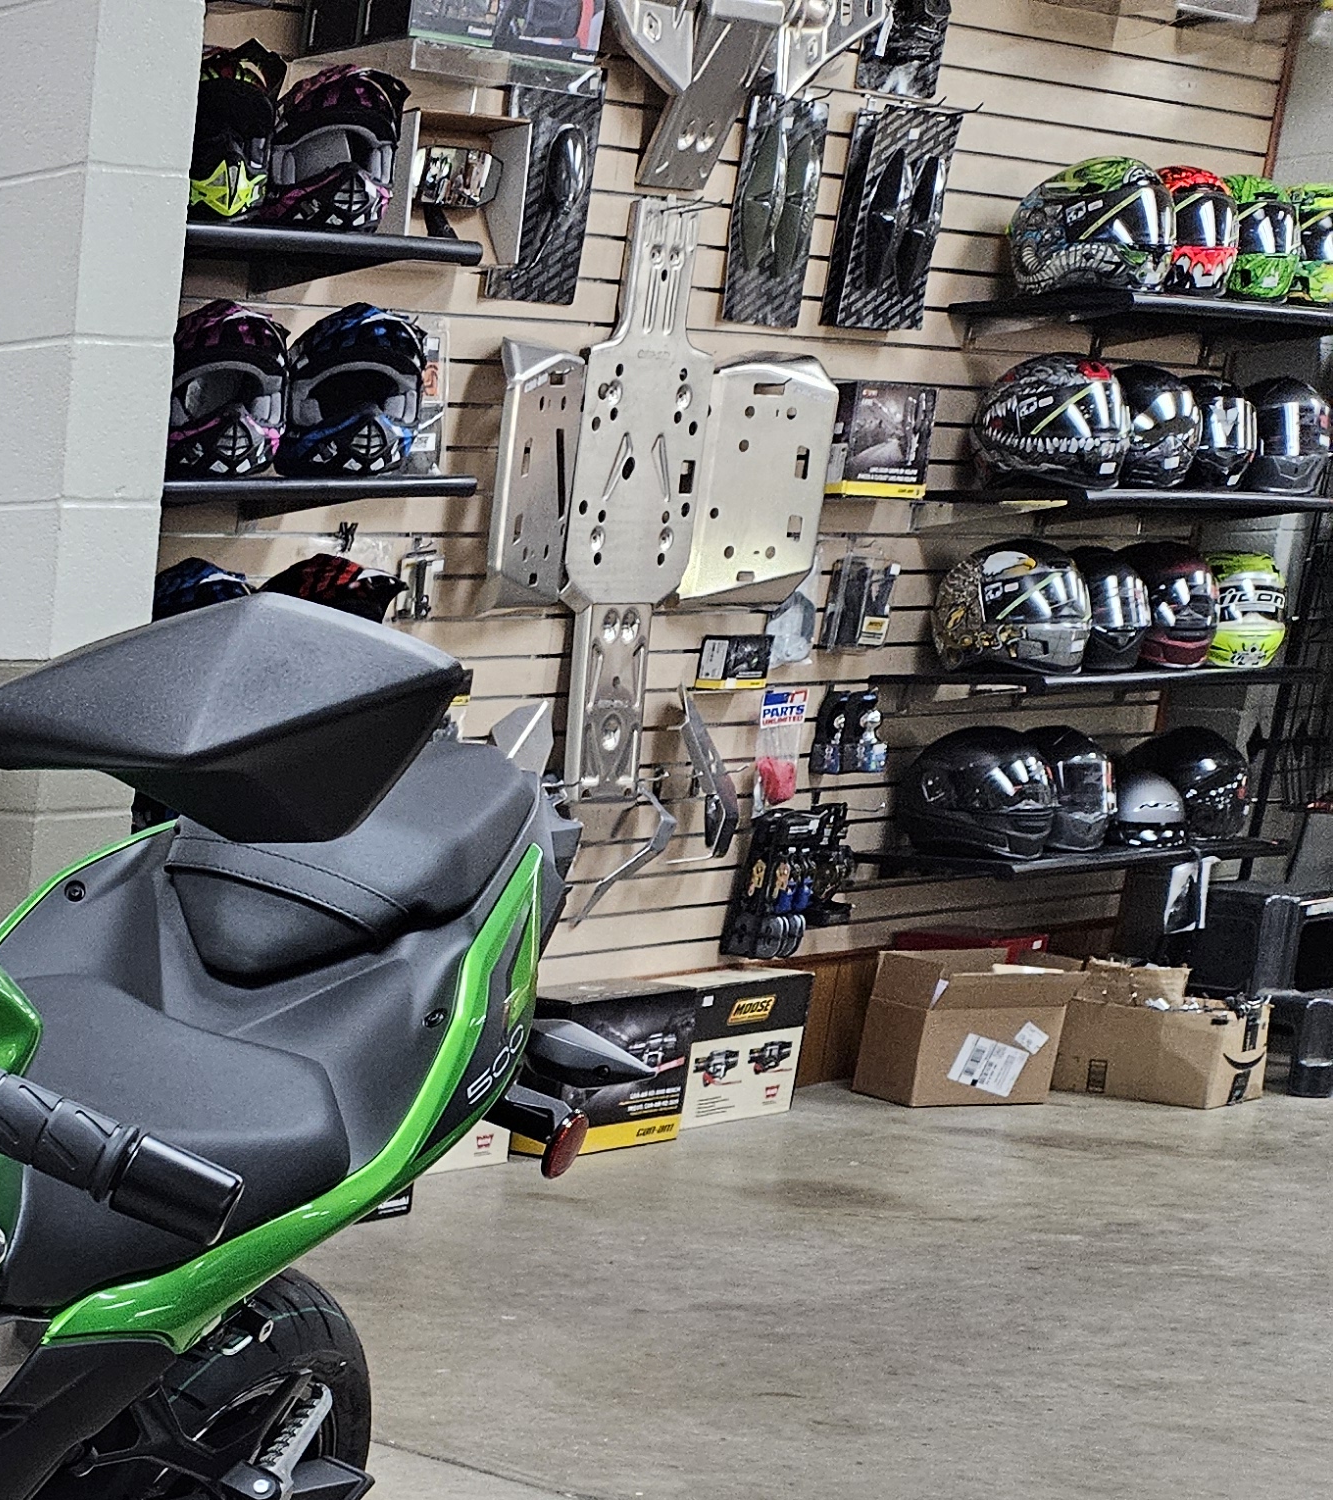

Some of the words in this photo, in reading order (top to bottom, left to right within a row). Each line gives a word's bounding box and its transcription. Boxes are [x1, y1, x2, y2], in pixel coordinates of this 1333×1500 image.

[762, 704, 805, 718] PARTS
[732, 999, 772, 1017] MOOSE
[466, 1023, 525, 1106] 500
